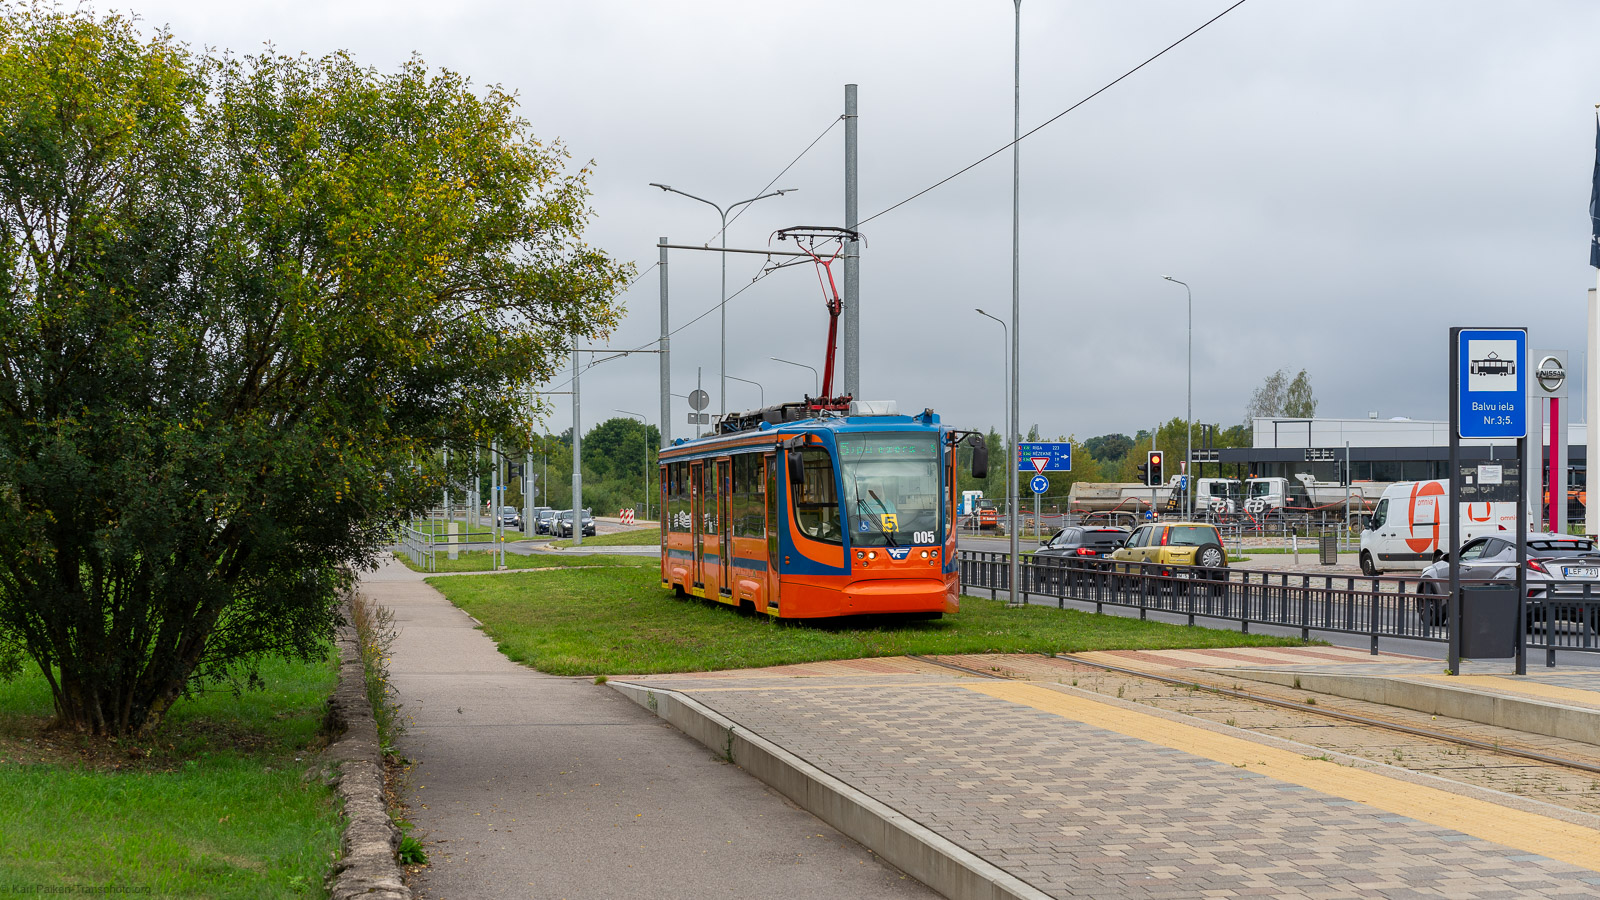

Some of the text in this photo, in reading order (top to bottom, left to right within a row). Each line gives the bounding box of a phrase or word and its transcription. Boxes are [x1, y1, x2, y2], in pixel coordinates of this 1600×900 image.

[1472, 401, 1514, 411] Balvu iela
[1483, 416, 1513, 425] Nr.3;5.
[840, 442, 849, 455] 5
[884, 516, 897, 531] 5
[913, 531, 935, 544] 005
